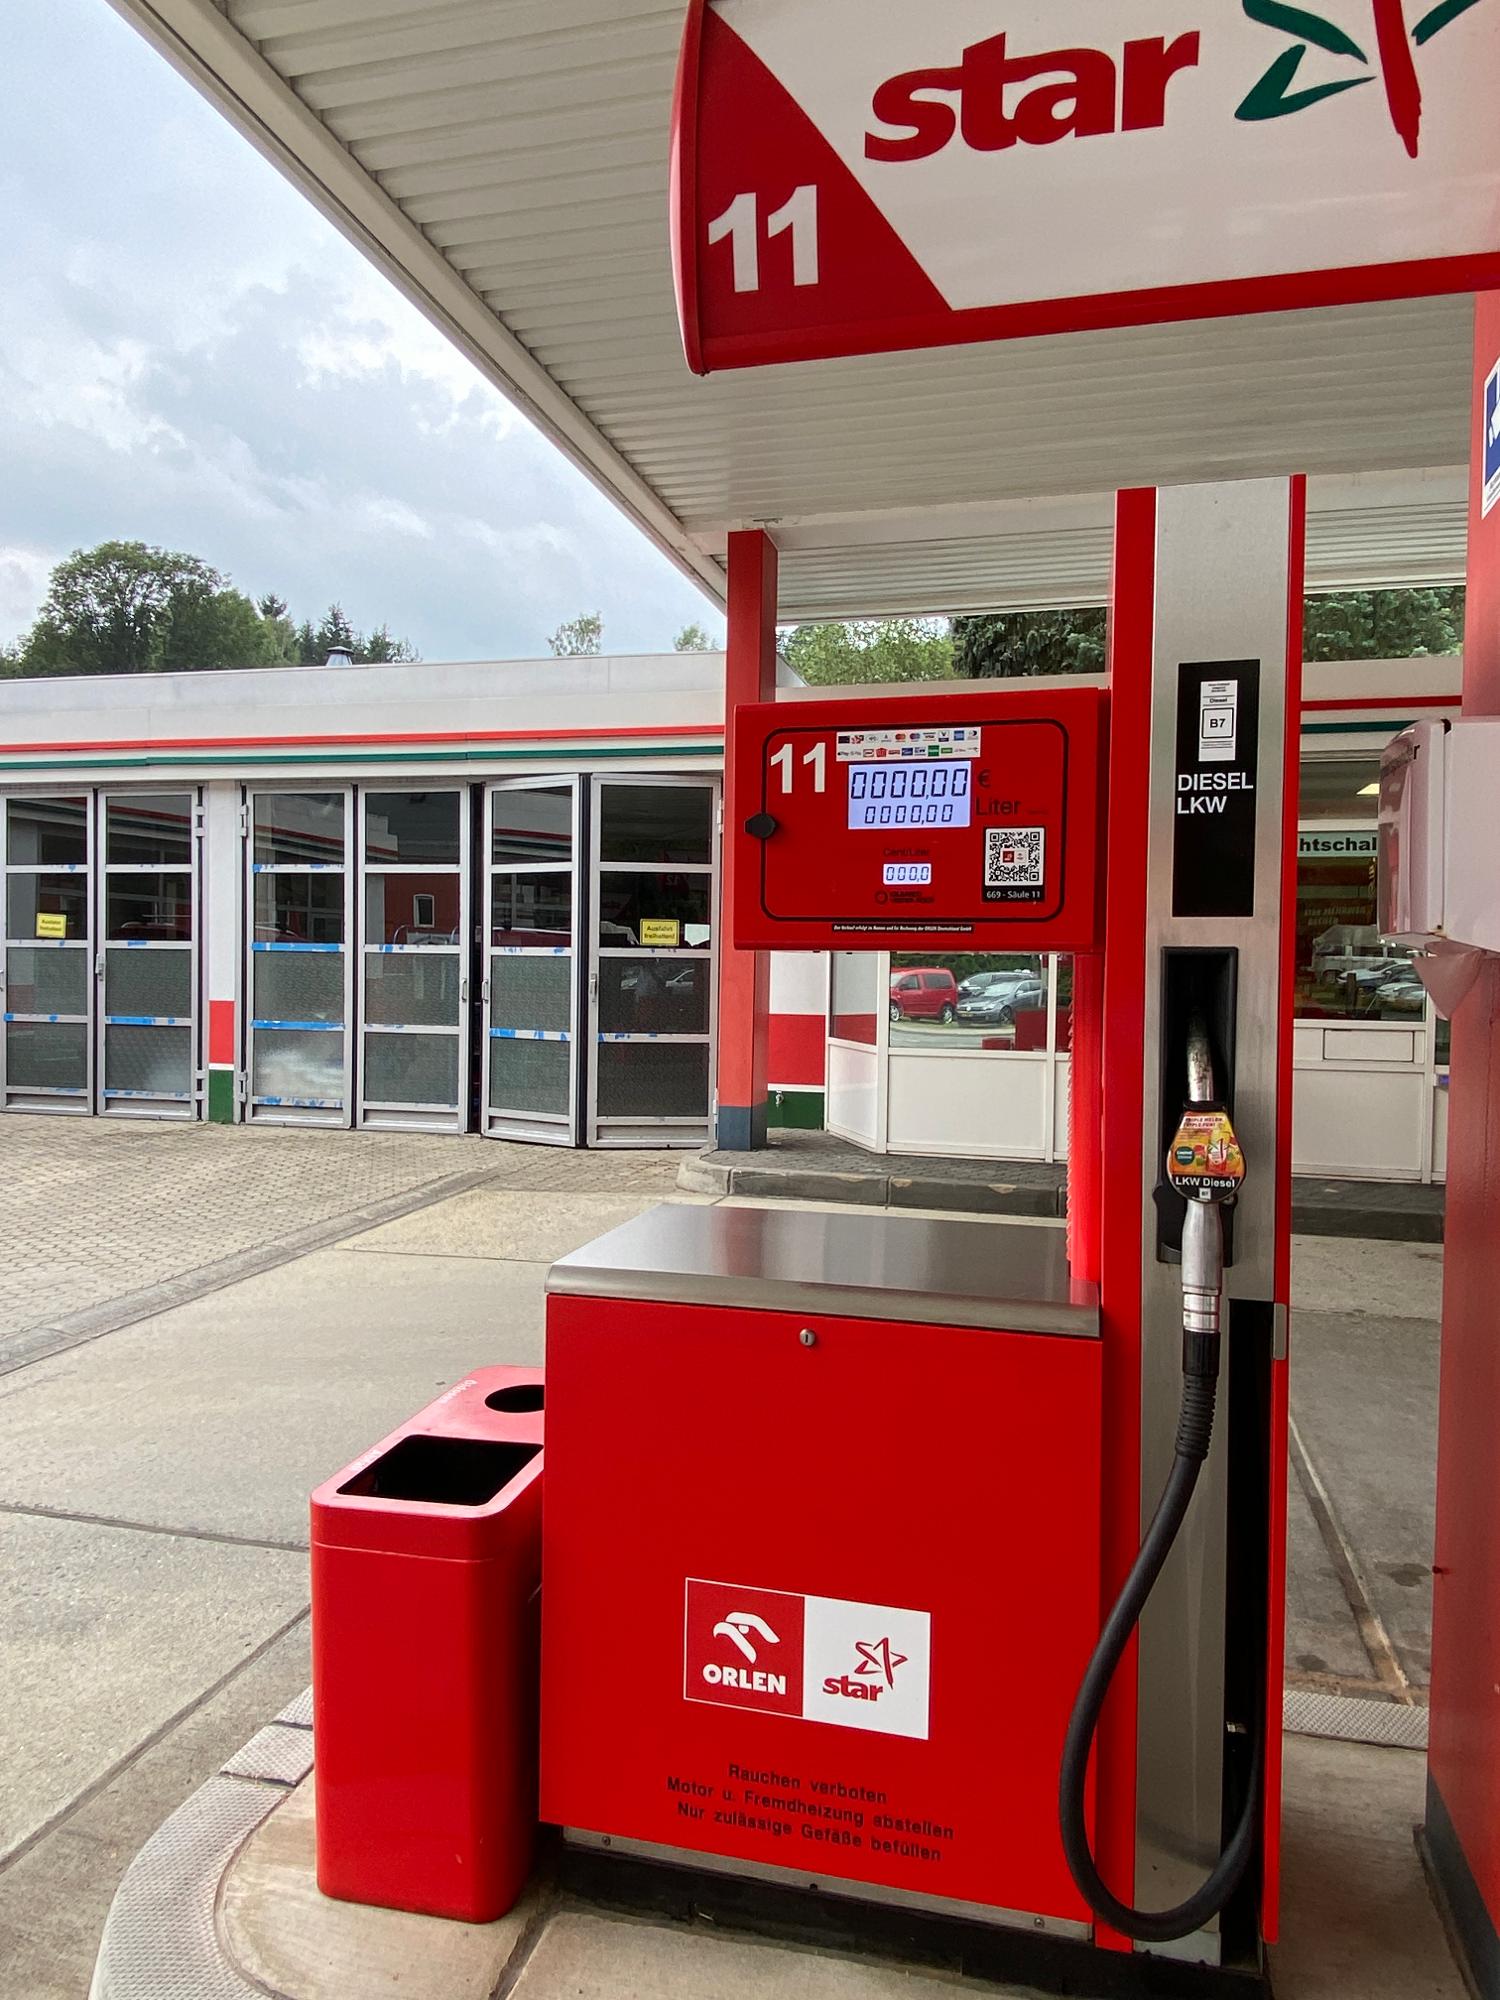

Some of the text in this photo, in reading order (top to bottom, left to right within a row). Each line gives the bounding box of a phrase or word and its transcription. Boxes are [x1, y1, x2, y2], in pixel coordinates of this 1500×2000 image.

[865, 31, 1199, 162] star
[708, 184, 820, 293] 11
[1209, 718, 1226, 728] B7
[770, 742, 826, 794] 11
[978, 768, 991, 788] €
[1177, 772, 1254, 791] DIESEL
[864, 804, 953, 824] 0000,00
[976, 797, 1021, 816] Liter
[1177, 796, 1227, 814] LKW
[886, 866, 929, 882] 000,0
[986, 890, 1001, 899] 669
[1008, 890, 1030, 899] Säule
[1032, 890, 1041, 898] 11
[1175, 1177, 1235, 1187] LKW Diesel
[702, 1663, 786, 1695] ORLEN
[822, 1675, 883, 1701] star
[729, 1763, 887, 1804] Rauchen verboten
[667, 1776, 714, 1797] Motor
[744, 1790, 864, 1827] Fremdheizung
[873, 1815, 954, 1840] abstellen
[678, 1802, 941, 1861] Nur zulässige Gefäße befüllen
